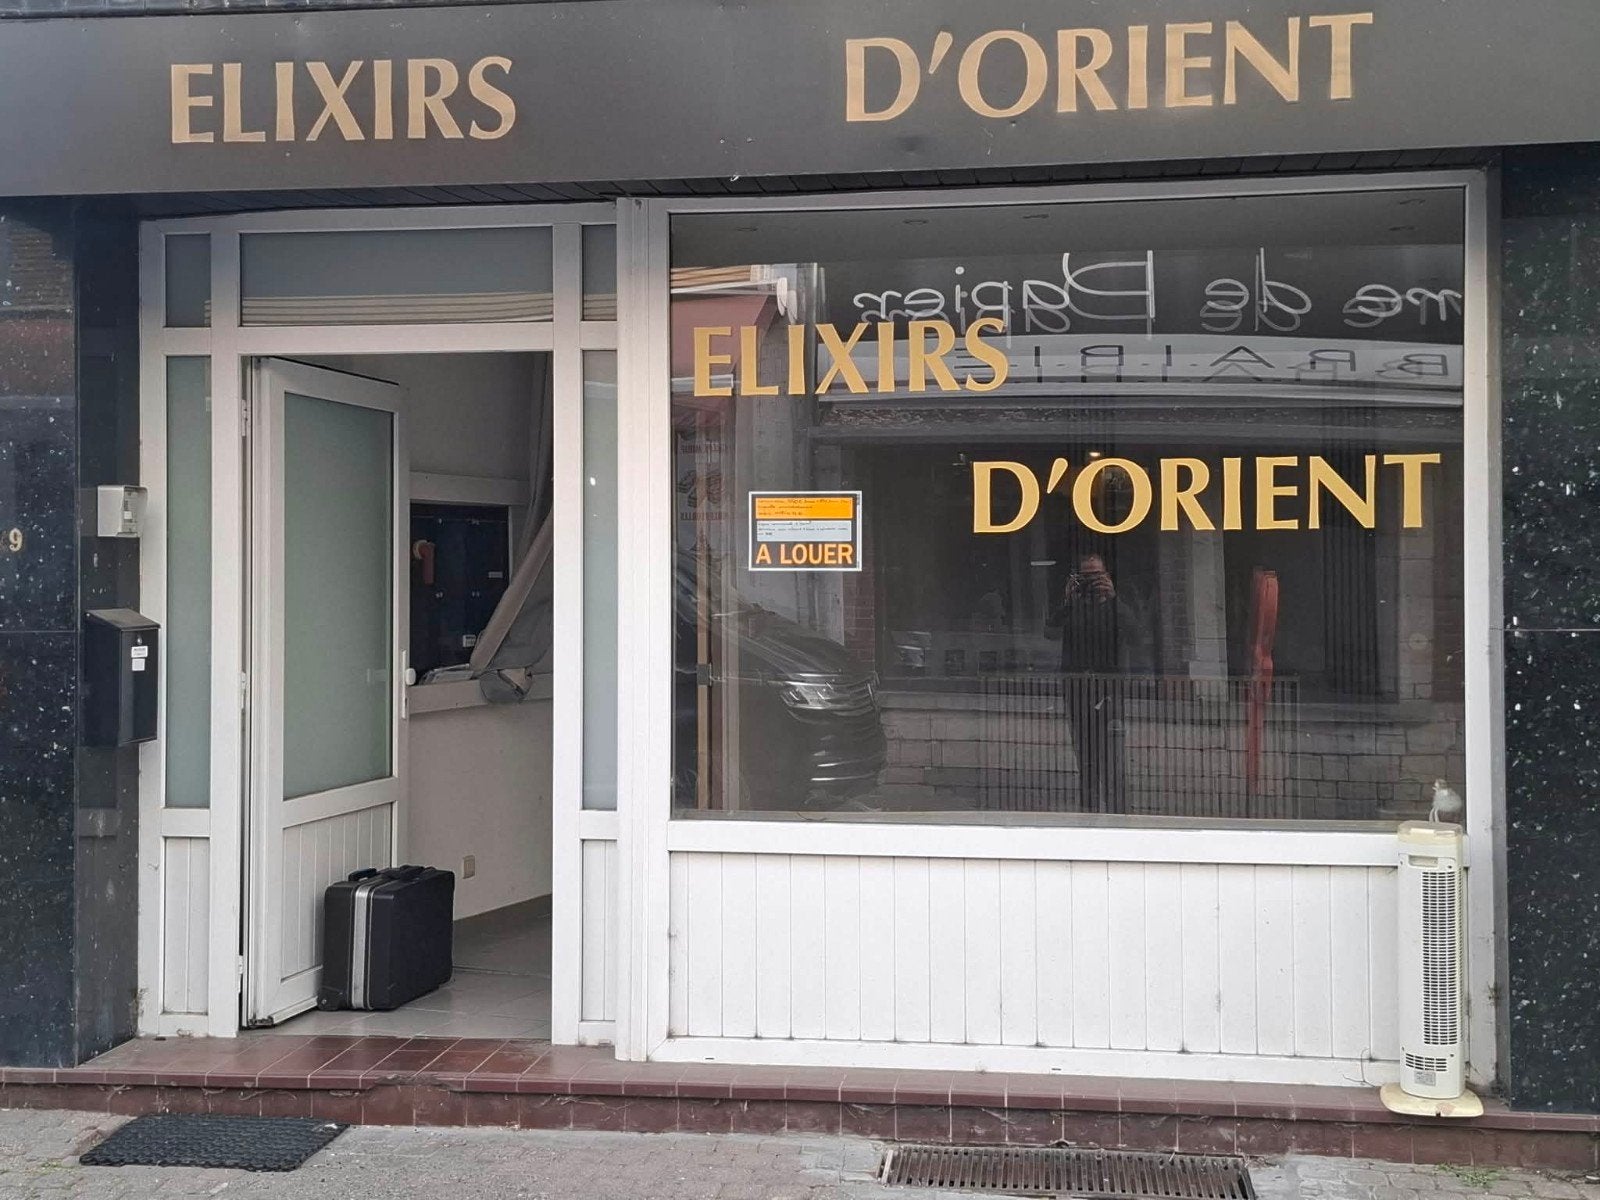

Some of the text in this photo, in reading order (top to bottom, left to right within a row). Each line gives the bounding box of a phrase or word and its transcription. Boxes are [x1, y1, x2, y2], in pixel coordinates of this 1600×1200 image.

[171, 12, 1374, 143] ELIXIRS D'ORIENT
[692, 317, 1010, 398] ELIXIRS
[971, 451, 1442, 536] D'ORIENT
[756, 543, 853, 565] A LOUER
